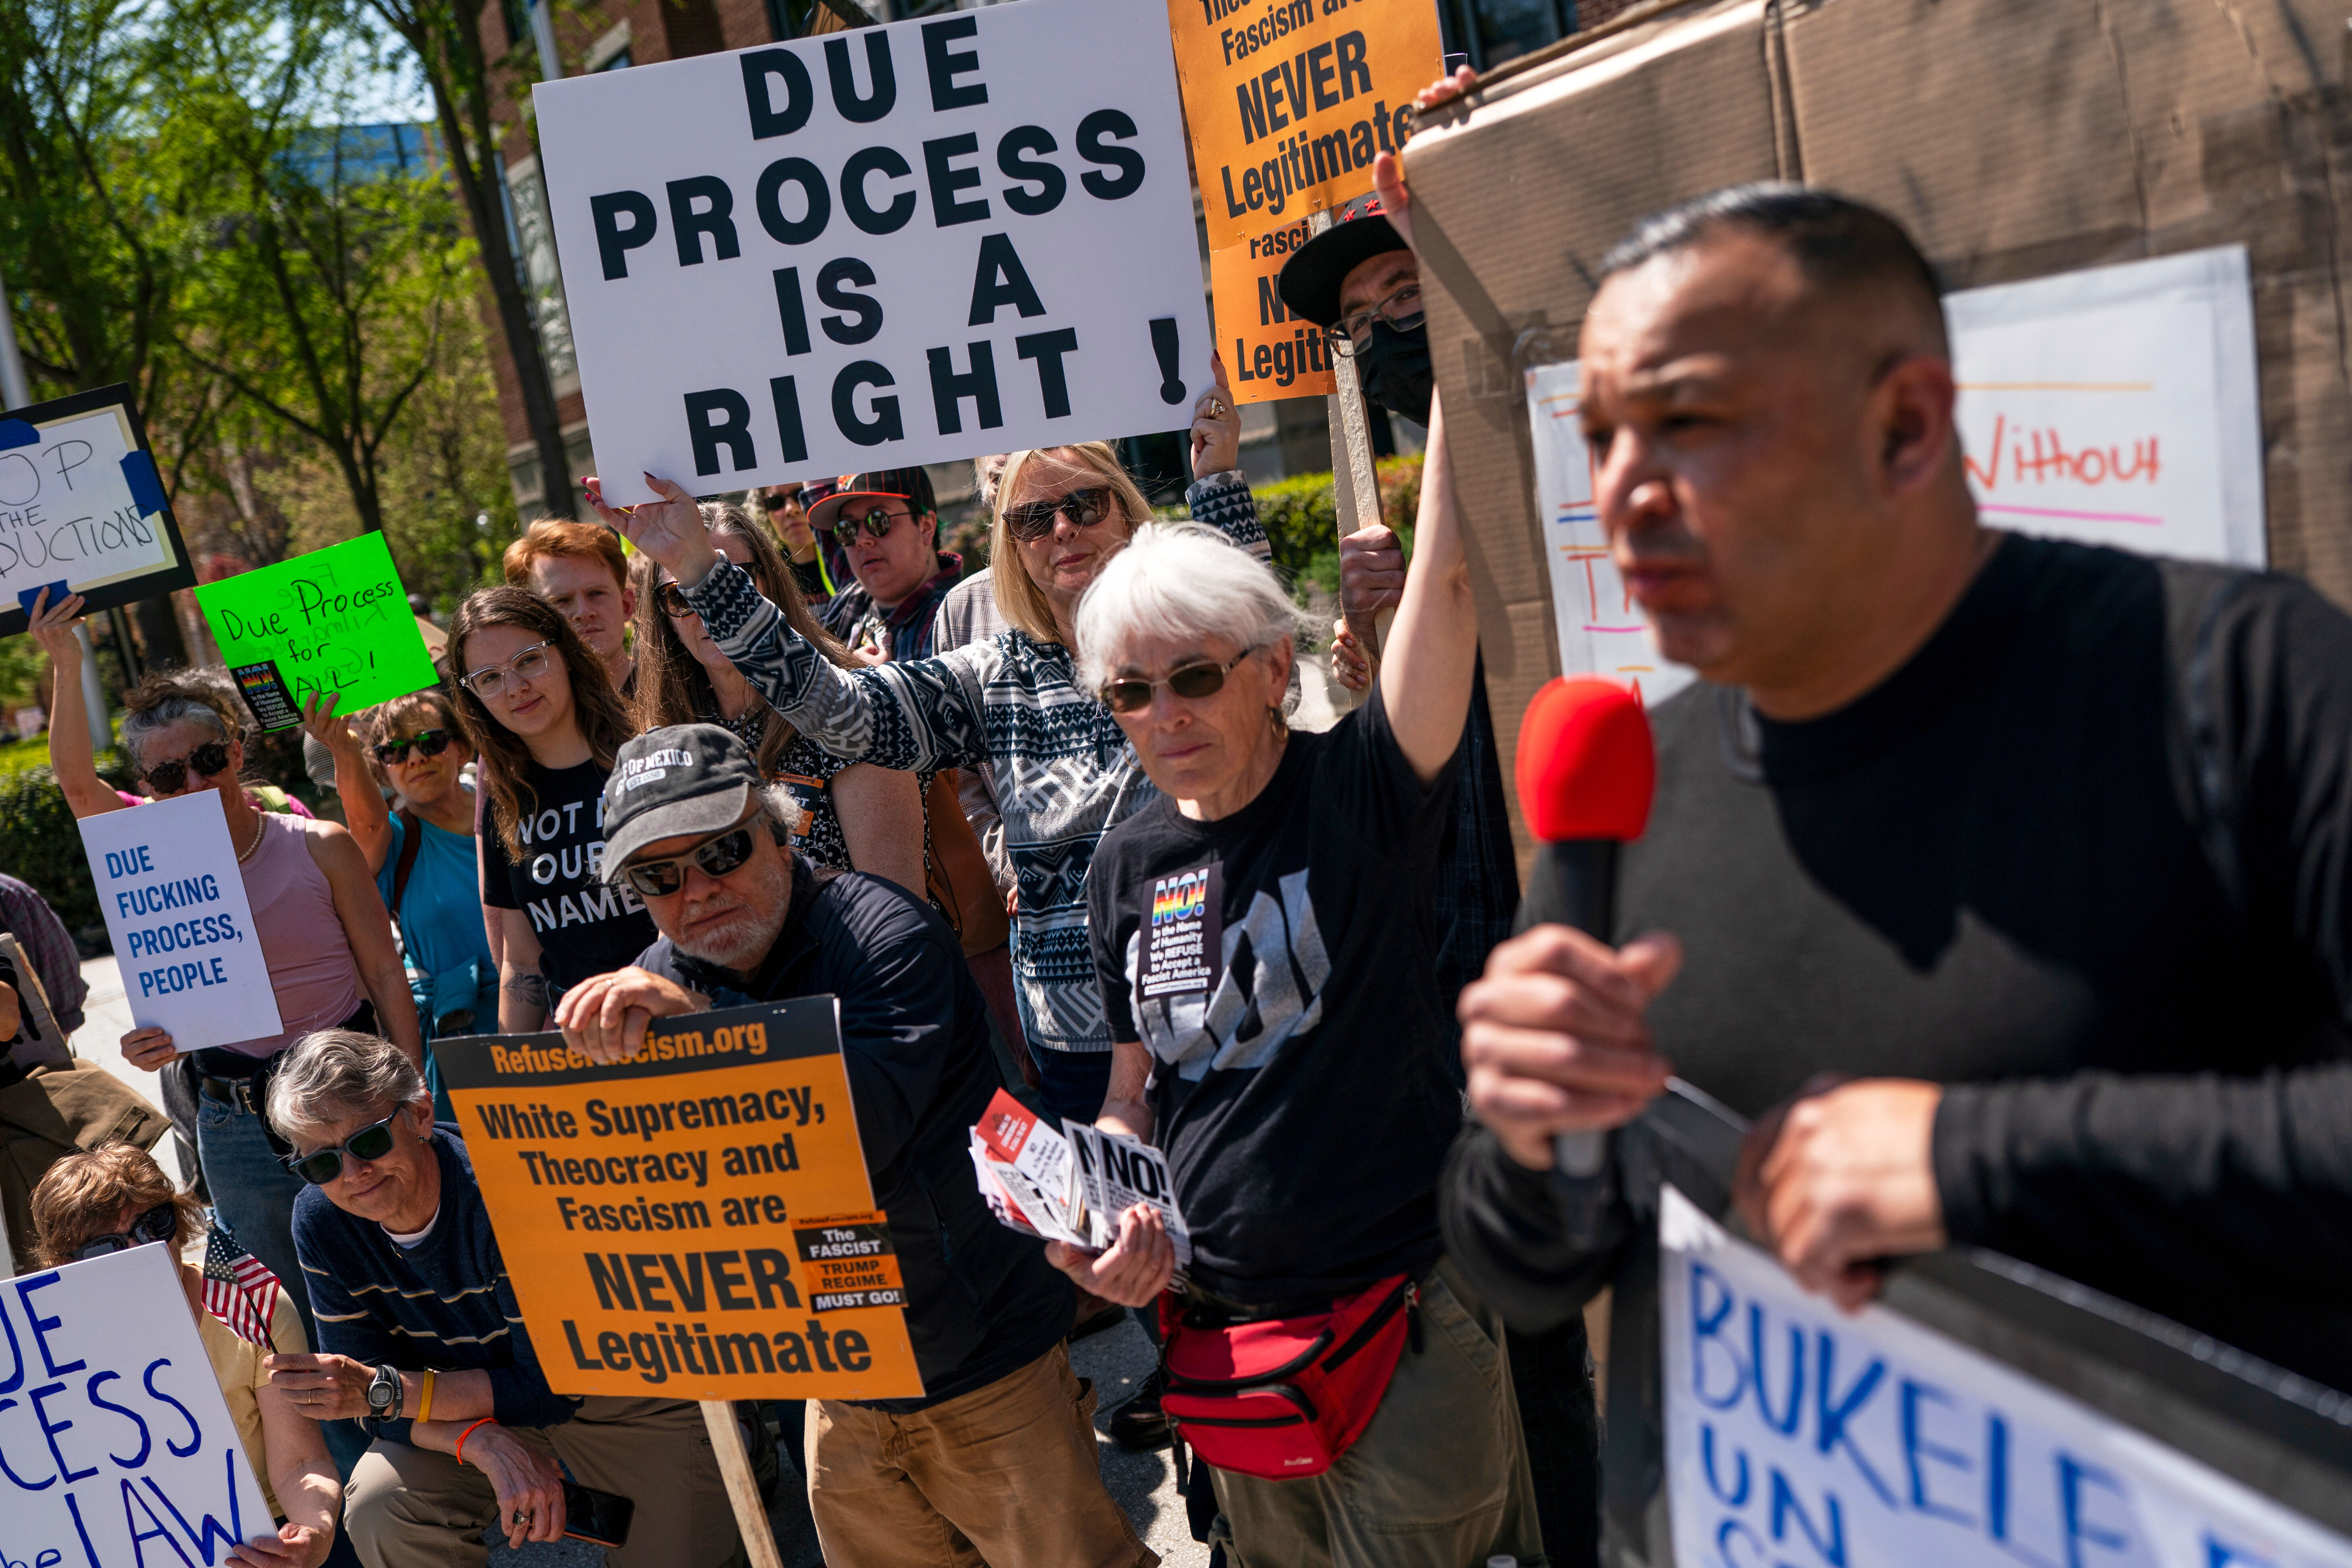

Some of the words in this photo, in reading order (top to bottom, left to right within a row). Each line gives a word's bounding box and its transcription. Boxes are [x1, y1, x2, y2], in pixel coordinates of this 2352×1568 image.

[1220, 0, 1314, 66] Fascism
[739, 15, 989, 141] DUE
[1236, 29, 1373, 145] NEVER
[1220, 100, 1413, 219] Legitimate
[589, 108, 1146, 281] PROCESS
[1250, 220, 1310, 260] Fasci
[772, 257, 884, 356] IS
[968, 232, 1046, 327] A
[1236, 325, 1334, 387] Legiti
[684, 327, 1078, 477] RIGHT
[0, 440, 92, 506] OP
[0, 504, 152, 578] DUCTIONS
[221, 609, 288, 641] Due
[291, 580, 393, 625] Process
[289, 639, 330, 663] for
[237, 664, 277, 695] NO!
[260, 697, 283, 706] Humanity
[266, 702, 287, 711] REFUSE
[628, 759, 644, 776] OF
[645, 748, 693, 771] MEXICO
[514, 801, 583, 846] NOT
[105, 845, 154, 879] DUE
[532, 841, 607, 885] OUR
[116, 874, 220, 919] FUCKING
[527, 883, 646, 932] NAME
[1152, 868, 1209, 927] NO!
[127, 913, 243, 958] PROCESS,
[1151, 938, 1161, 950] of
[1161, 930, 1203, 948] Humanity
[1152, 928, 1161, 939] In
[1161, 925, 1176, 937] the
[1176, 920, 1202, 933] Name
[1150, 951, 1164, 962] We
[1164, 943, 1204, 959] REFUSE
[1151, 963, 1160, 973] to
[1161, 957, 1193, 970] Accept
[1194, 957, 1201, 966] a
[138, 957, 228, 998] PEOPLE
[1142, 970, 1171, 986] Fascist
[1172, 966, 1211, 980] America
[490, 1022, 768, 1074] Refusecism.org
[476, 1102, 578, 1140] White
[585, 1084, 825, 1142] Supremacy,
[518, 1149, 708, 1188] Theocracy
[723, 1134, 800, 1177] and
[1101, 1136, 1170, 1205] NO!
[557, 1196, 709, 1232] Fascism
[722, 1194, 787, 1227] are
[822, 1228, 856, 1243] The
[809, 1240, 881, 1258] FASCIST
[819, 1261, 879, 1275] TRUMP
[584, 1248, 803, 1313] NEVER
[816, 1292, 864, 1310] MUST
[869, 1291, 900, 1304] GO!
[822, 1273, 887, 1289] REGIME
[561, 1320, 872, 1384] Legitimate
[0, 1358, 202, 1491] CESS
